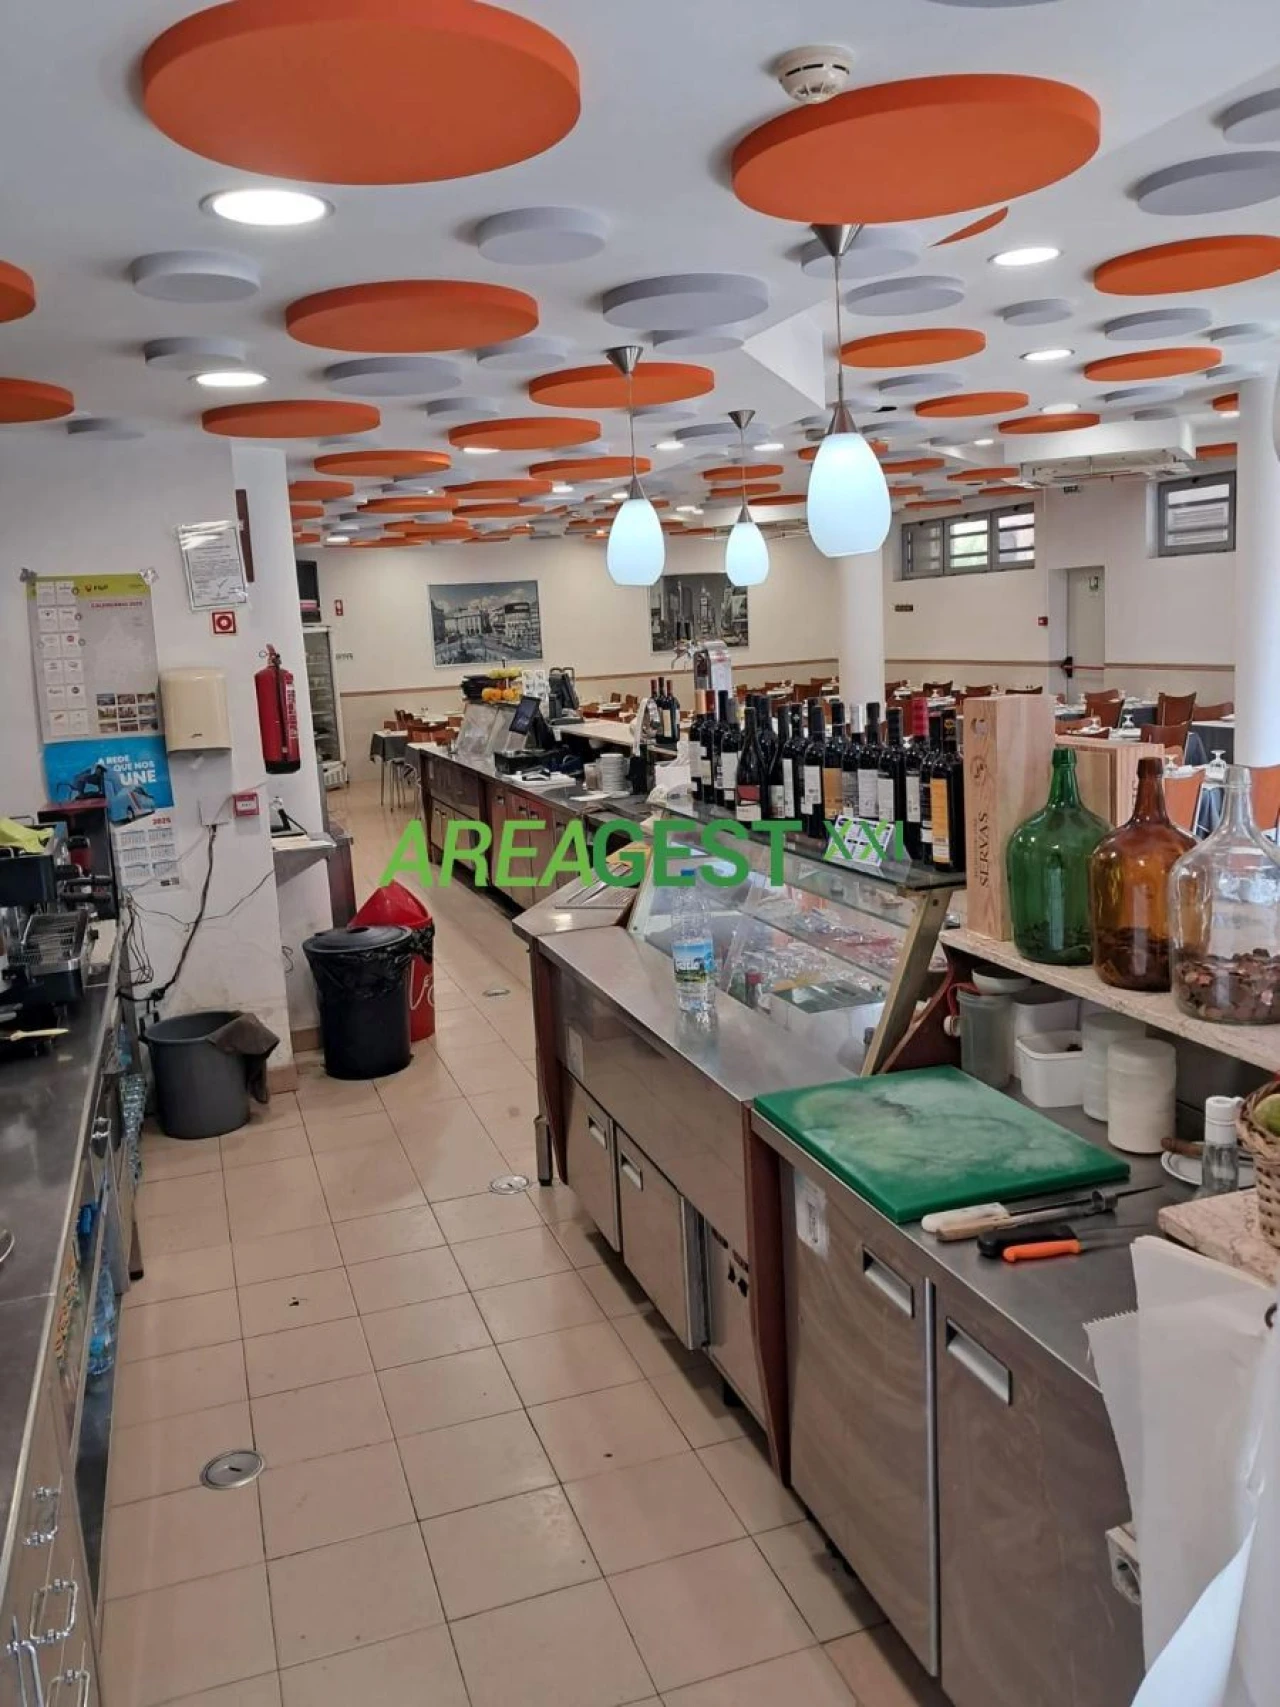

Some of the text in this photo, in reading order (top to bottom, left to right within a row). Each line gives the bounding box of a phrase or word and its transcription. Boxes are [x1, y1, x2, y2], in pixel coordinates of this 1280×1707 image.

[113, 760, 155, 772] QUE NOS
[120, 769, 157, 786] UNE
[978, 811, 988, 888] SERVAS
